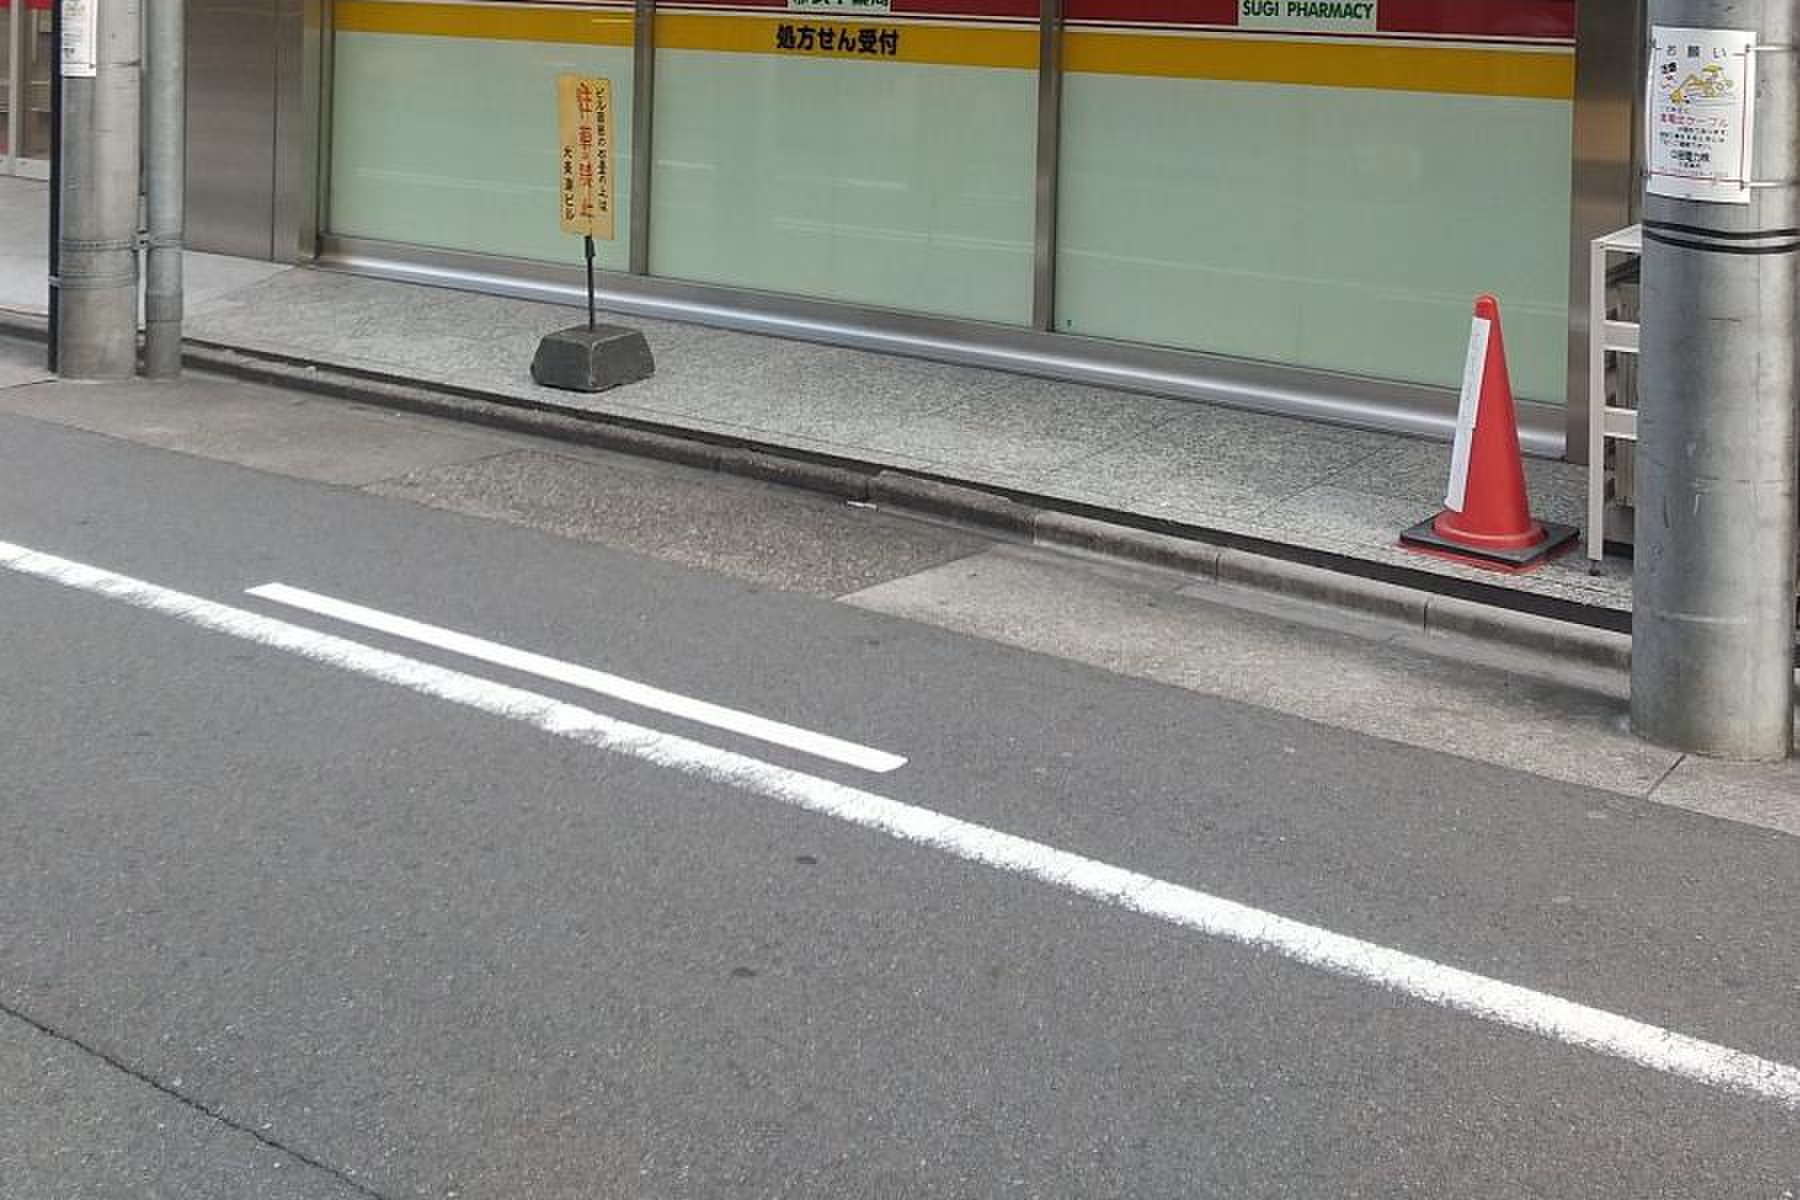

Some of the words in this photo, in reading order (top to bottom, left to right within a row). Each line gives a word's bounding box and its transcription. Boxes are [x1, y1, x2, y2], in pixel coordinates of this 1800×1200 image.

[1242, 0, 1280, 17] SUGI
[1287, 1, 1374, 20] PHARMACY
[776, 24, 899, 55] 処方せん受付
